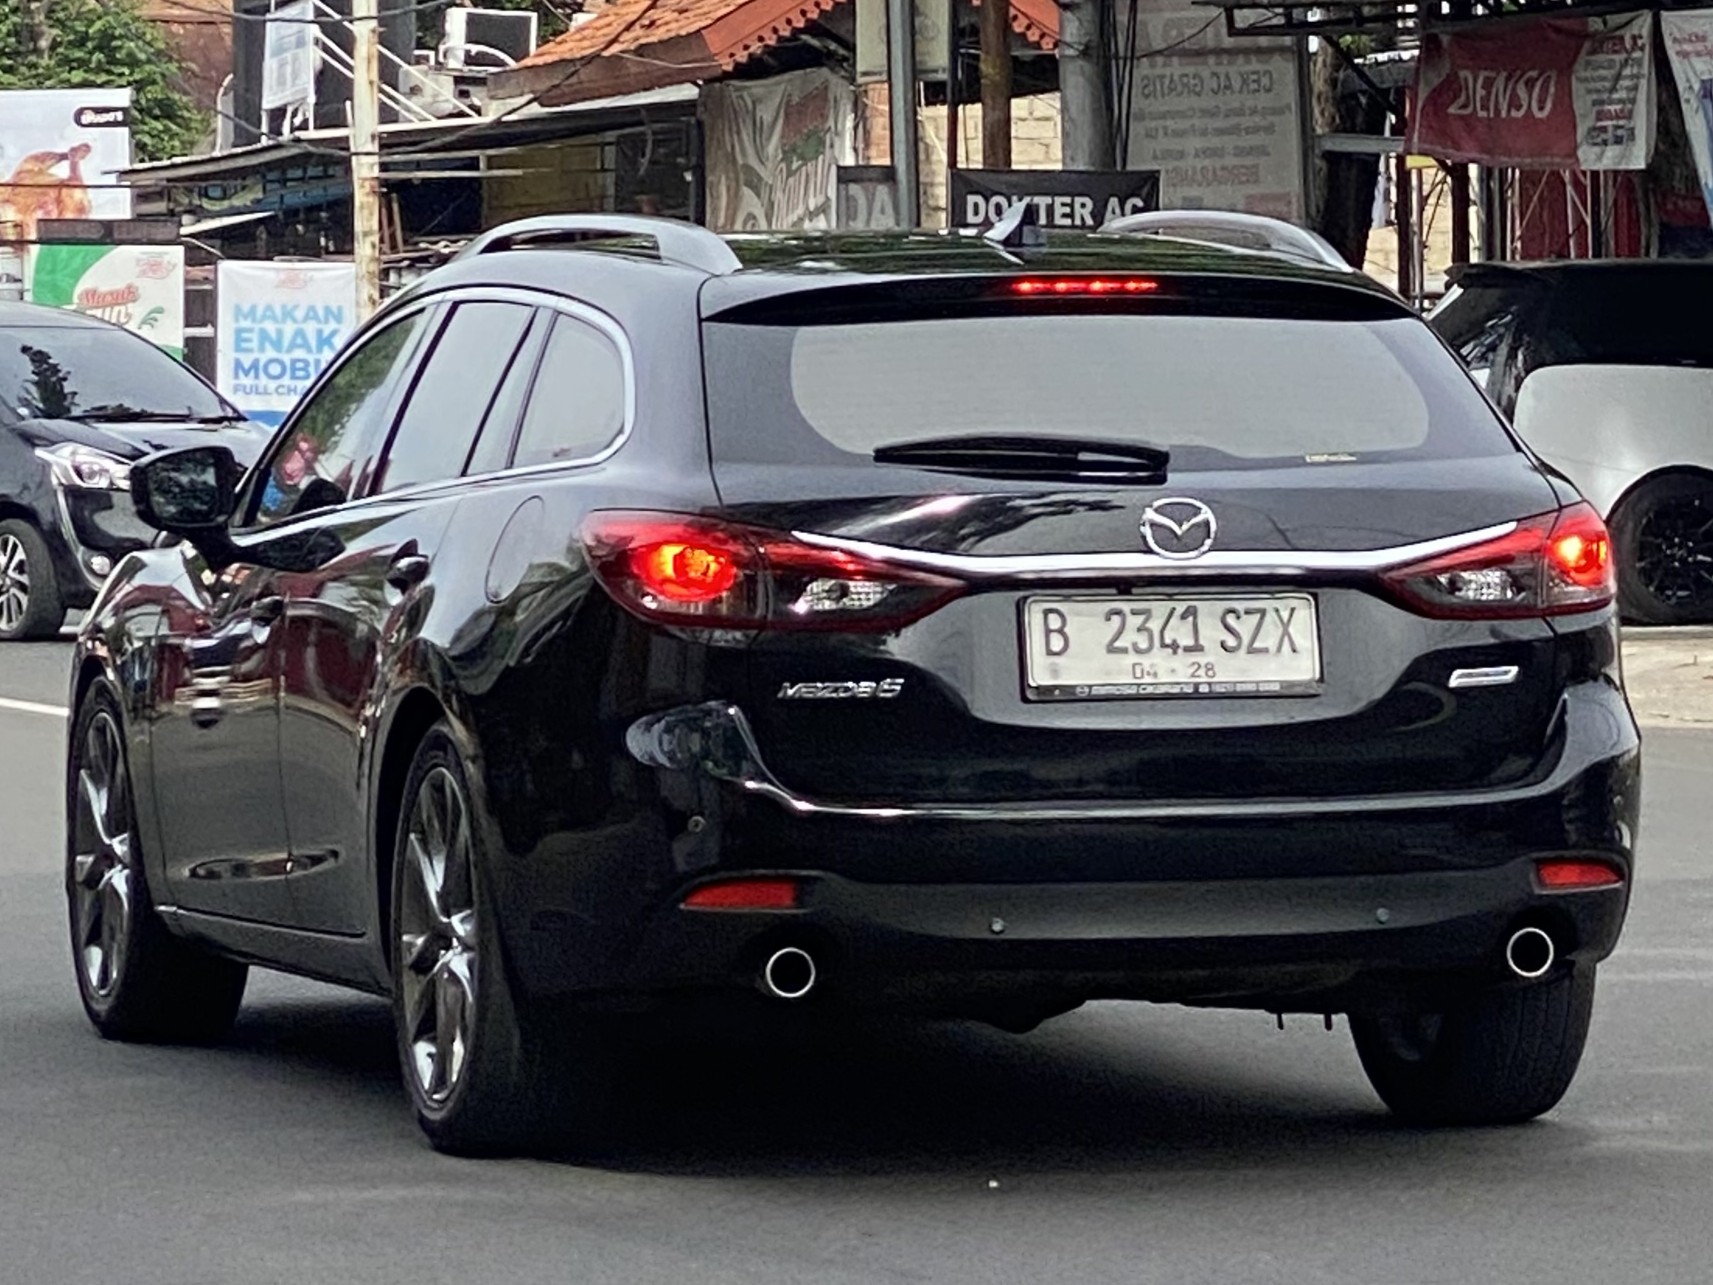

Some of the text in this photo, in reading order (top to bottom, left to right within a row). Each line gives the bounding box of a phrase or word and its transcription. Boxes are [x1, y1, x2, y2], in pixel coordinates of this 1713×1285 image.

[1447, 70, 1557, 118] DENSO
[966, 193, 1094, 226] DOTER
[233, 304, 343, 325] MAKAN
[234, 327, 340, 353] ENAK
[233, 357, 331, 381] MOBI
[233, 384, 272, 396] FULL
[1042, 605, 1299, 656] B 2341 SZX
[1189, 661, 1216, 678] 28
